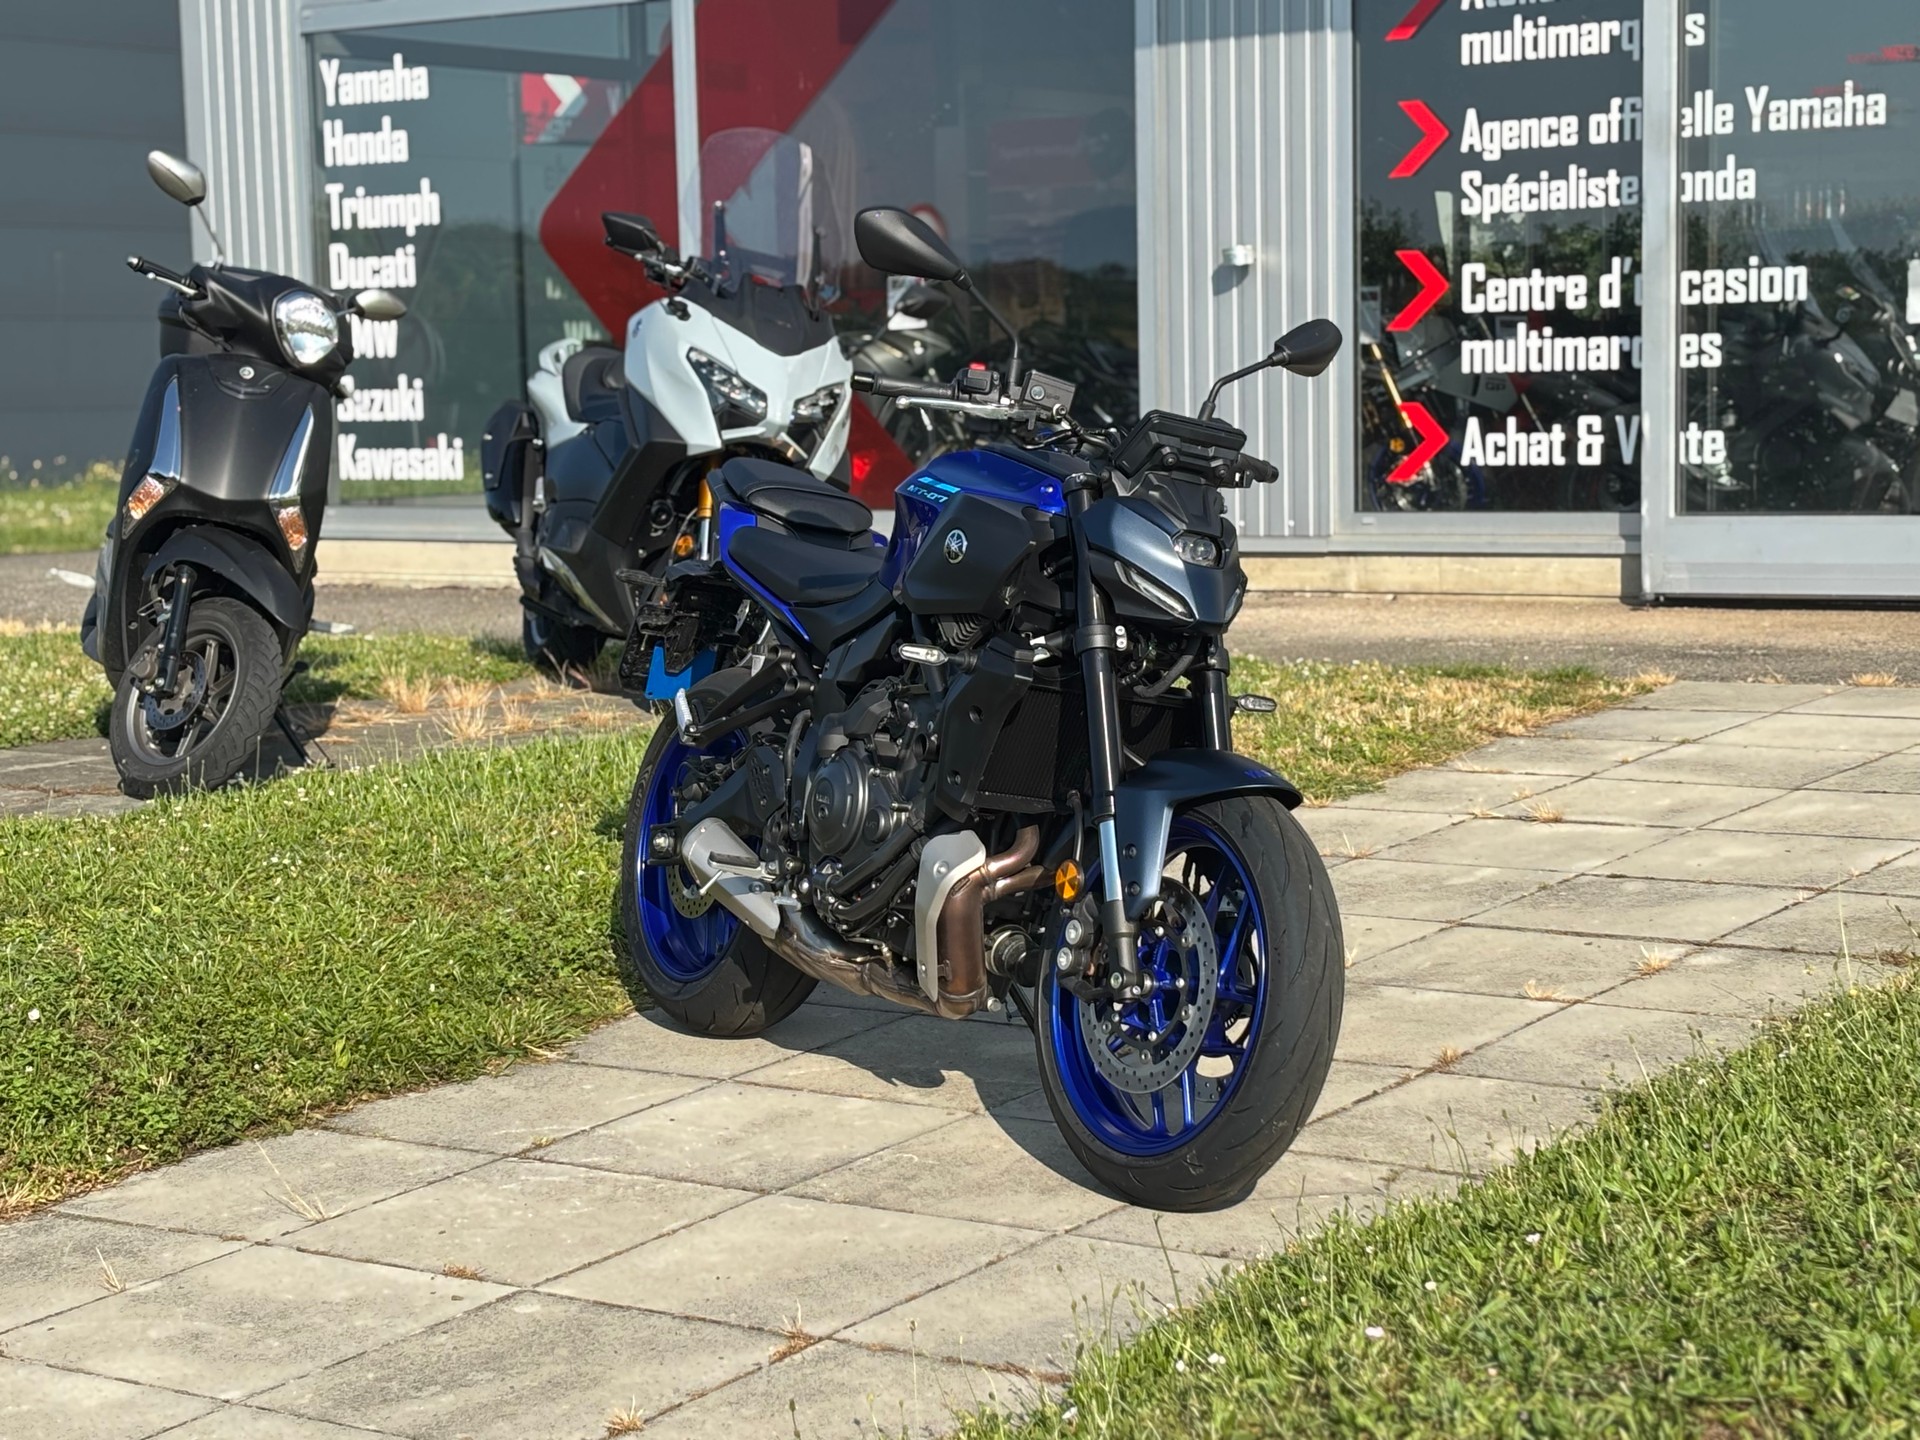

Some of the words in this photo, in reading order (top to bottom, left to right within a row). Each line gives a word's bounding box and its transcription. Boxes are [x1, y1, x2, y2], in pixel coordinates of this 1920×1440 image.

[1460, 13, 1706, 66] multimarqs
[319, 52, 430, 107] Yamaha
[322, 115, 409, 167] Honda
[1460, 107, 1578, 161] Agence
[1744, 80, 1886, 132] Yamaha
[324, 177, 441, 237] Triumph
[1460, 164, 1639, 224] Spécialiste
[1680, 153, 1756, 203] onda
[329, 242, 417, 290] Ducati
[1461, 262, 1587, 314] Centre
[346, 313, 399, 359] MW
[1460, 321, 1723, 375] multimares
[336, 373, 425, 422] Suzuki
[337, 432, 465, 481] Kawasaki
[1460, 415, 1566, 467] Achat
[1577, 414, 1605, 465] &
[1614, 414, 1726, 465] Vte
[906, 484, 949, 503] MT-07
